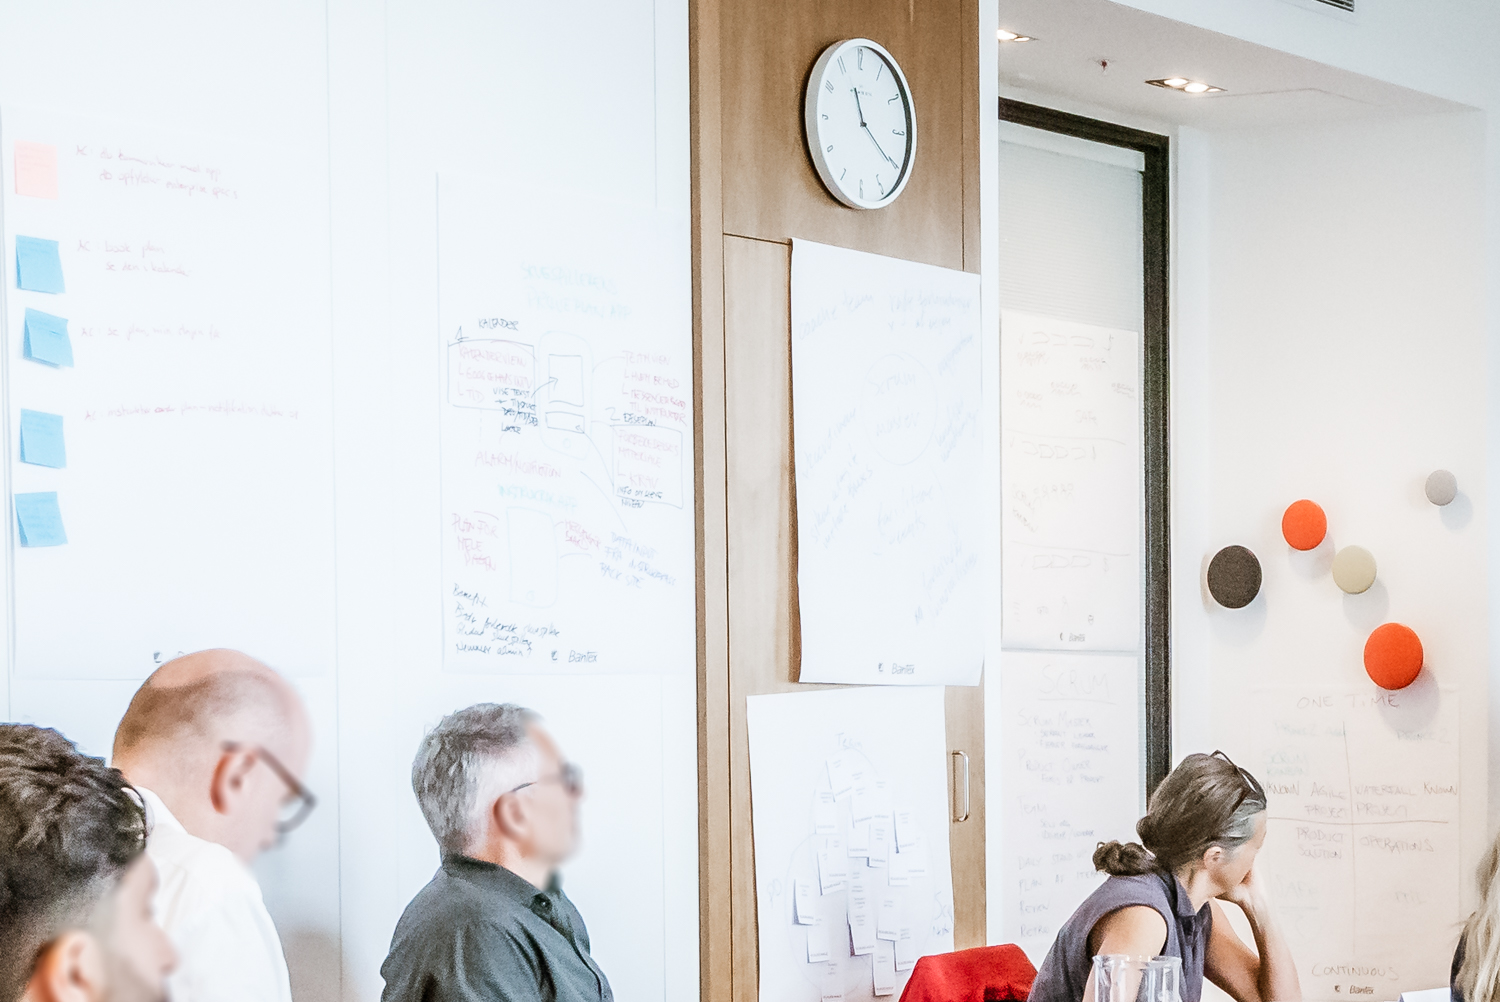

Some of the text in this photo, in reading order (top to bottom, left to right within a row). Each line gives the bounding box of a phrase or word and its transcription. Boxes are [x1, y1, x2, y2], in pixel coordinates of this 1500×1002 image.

[892, 128, 905, 137] 3
[1039, 664, 1110, 697] SCRUM
[1297, 696, 1334, 710] ONE
[1296, 827, 1345, 843] PRODUCT
[1359, 836, 1435, 856] OPERATIONS
[1312, 963, 1400, 981] CONTINUOUS
